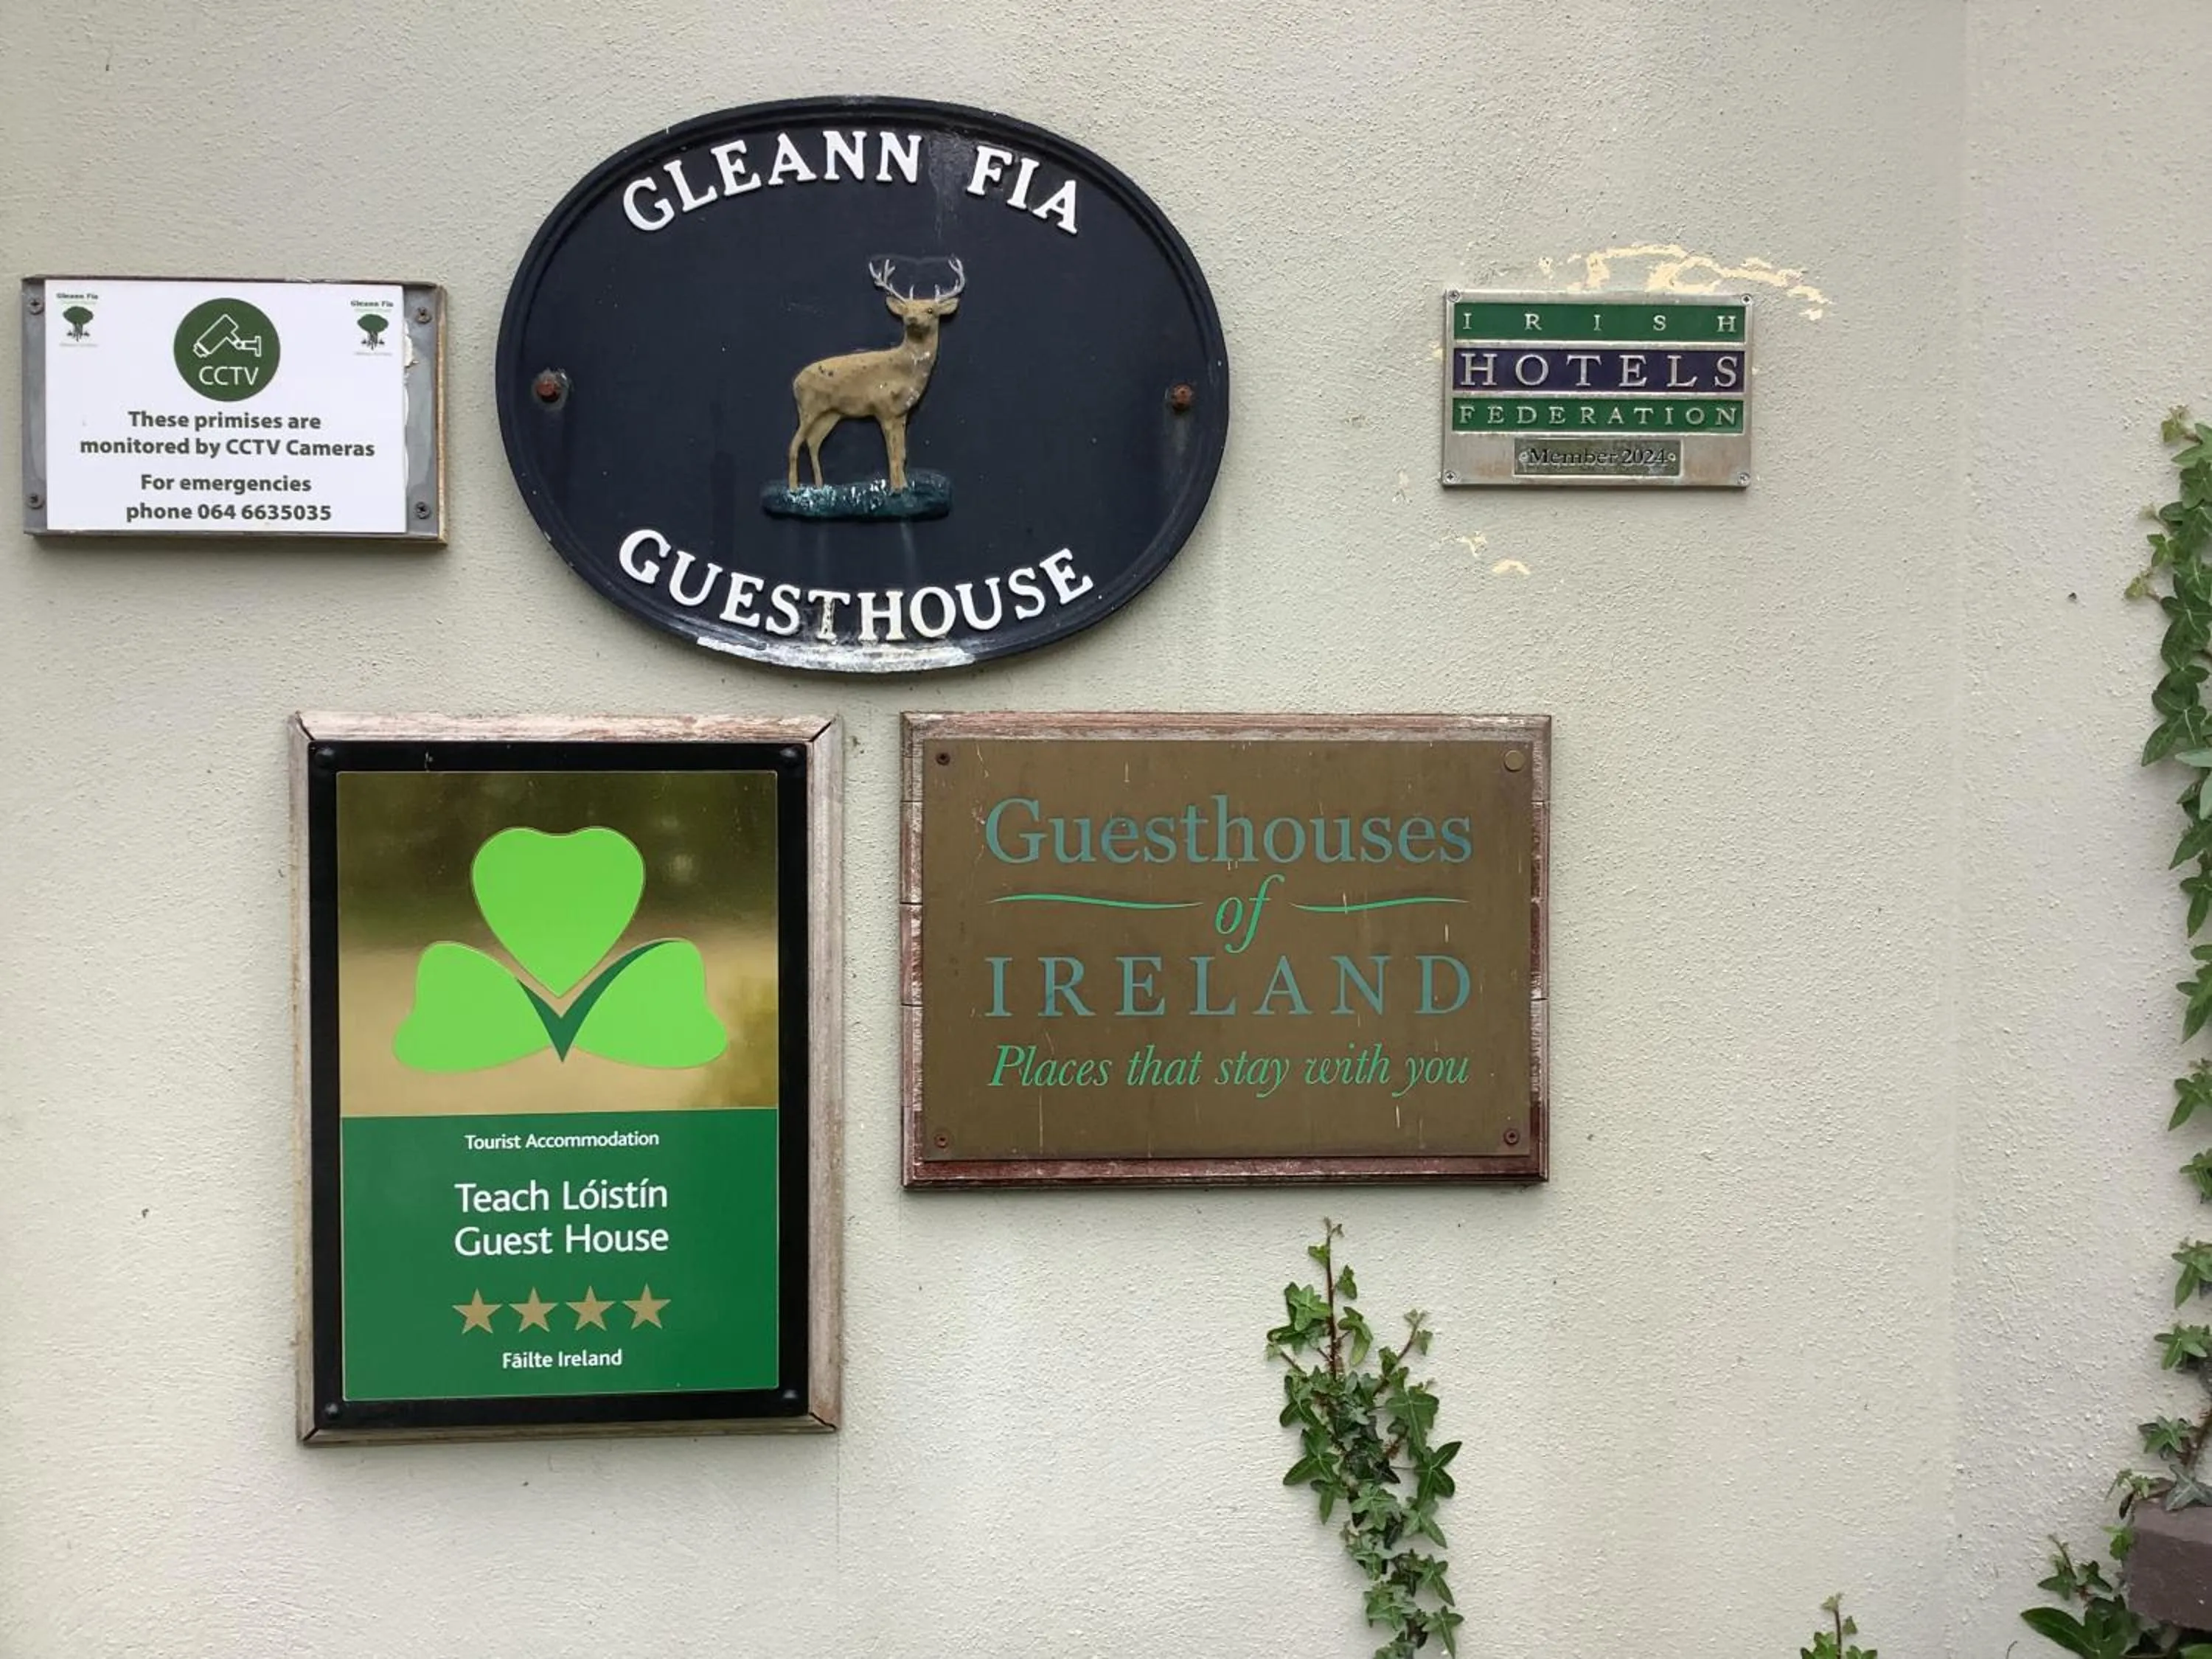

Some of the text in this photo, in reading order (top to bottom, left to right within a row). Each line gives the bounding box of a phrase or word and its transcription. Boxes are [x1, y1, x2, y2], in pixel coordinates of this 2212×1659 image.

[622, 130, 1079, 234] GLEANN FIA
[1462, 312, 1736, 333] IRISH
[198, 366, 259, 386] CCTV
[1459, 352, 1738, 387] HOTELS
[128, 411, 321, 432] These primises are
[1458, 406, 1737, 425] FEDERATION
[80, 437, 375, 458] monitored by CCTV Cameras
[1530, 448, 1667, 465] Member 2024
[141, 474, 312, 495] For emergencies
[126, 503, 331, 522] phone 064 6635035
[618, 528, 1093, 642] GUESTHOUSE
[984, 795, 1472, 865] Guesthouses
[1214, 873, 1285, 954] of
[984, 955, 1472, 1018] IRELAND
[988, 1042, 1470, 1098] Places that stay with you
[465, 1130, 659, 1150] Tourist Accommodation
[454, 1178, 668, 1213] Teach Lóistín
[454, 1223, 669, 1257] Guest House
[502, 1348, 622, 1369] Fáilte Ireland
